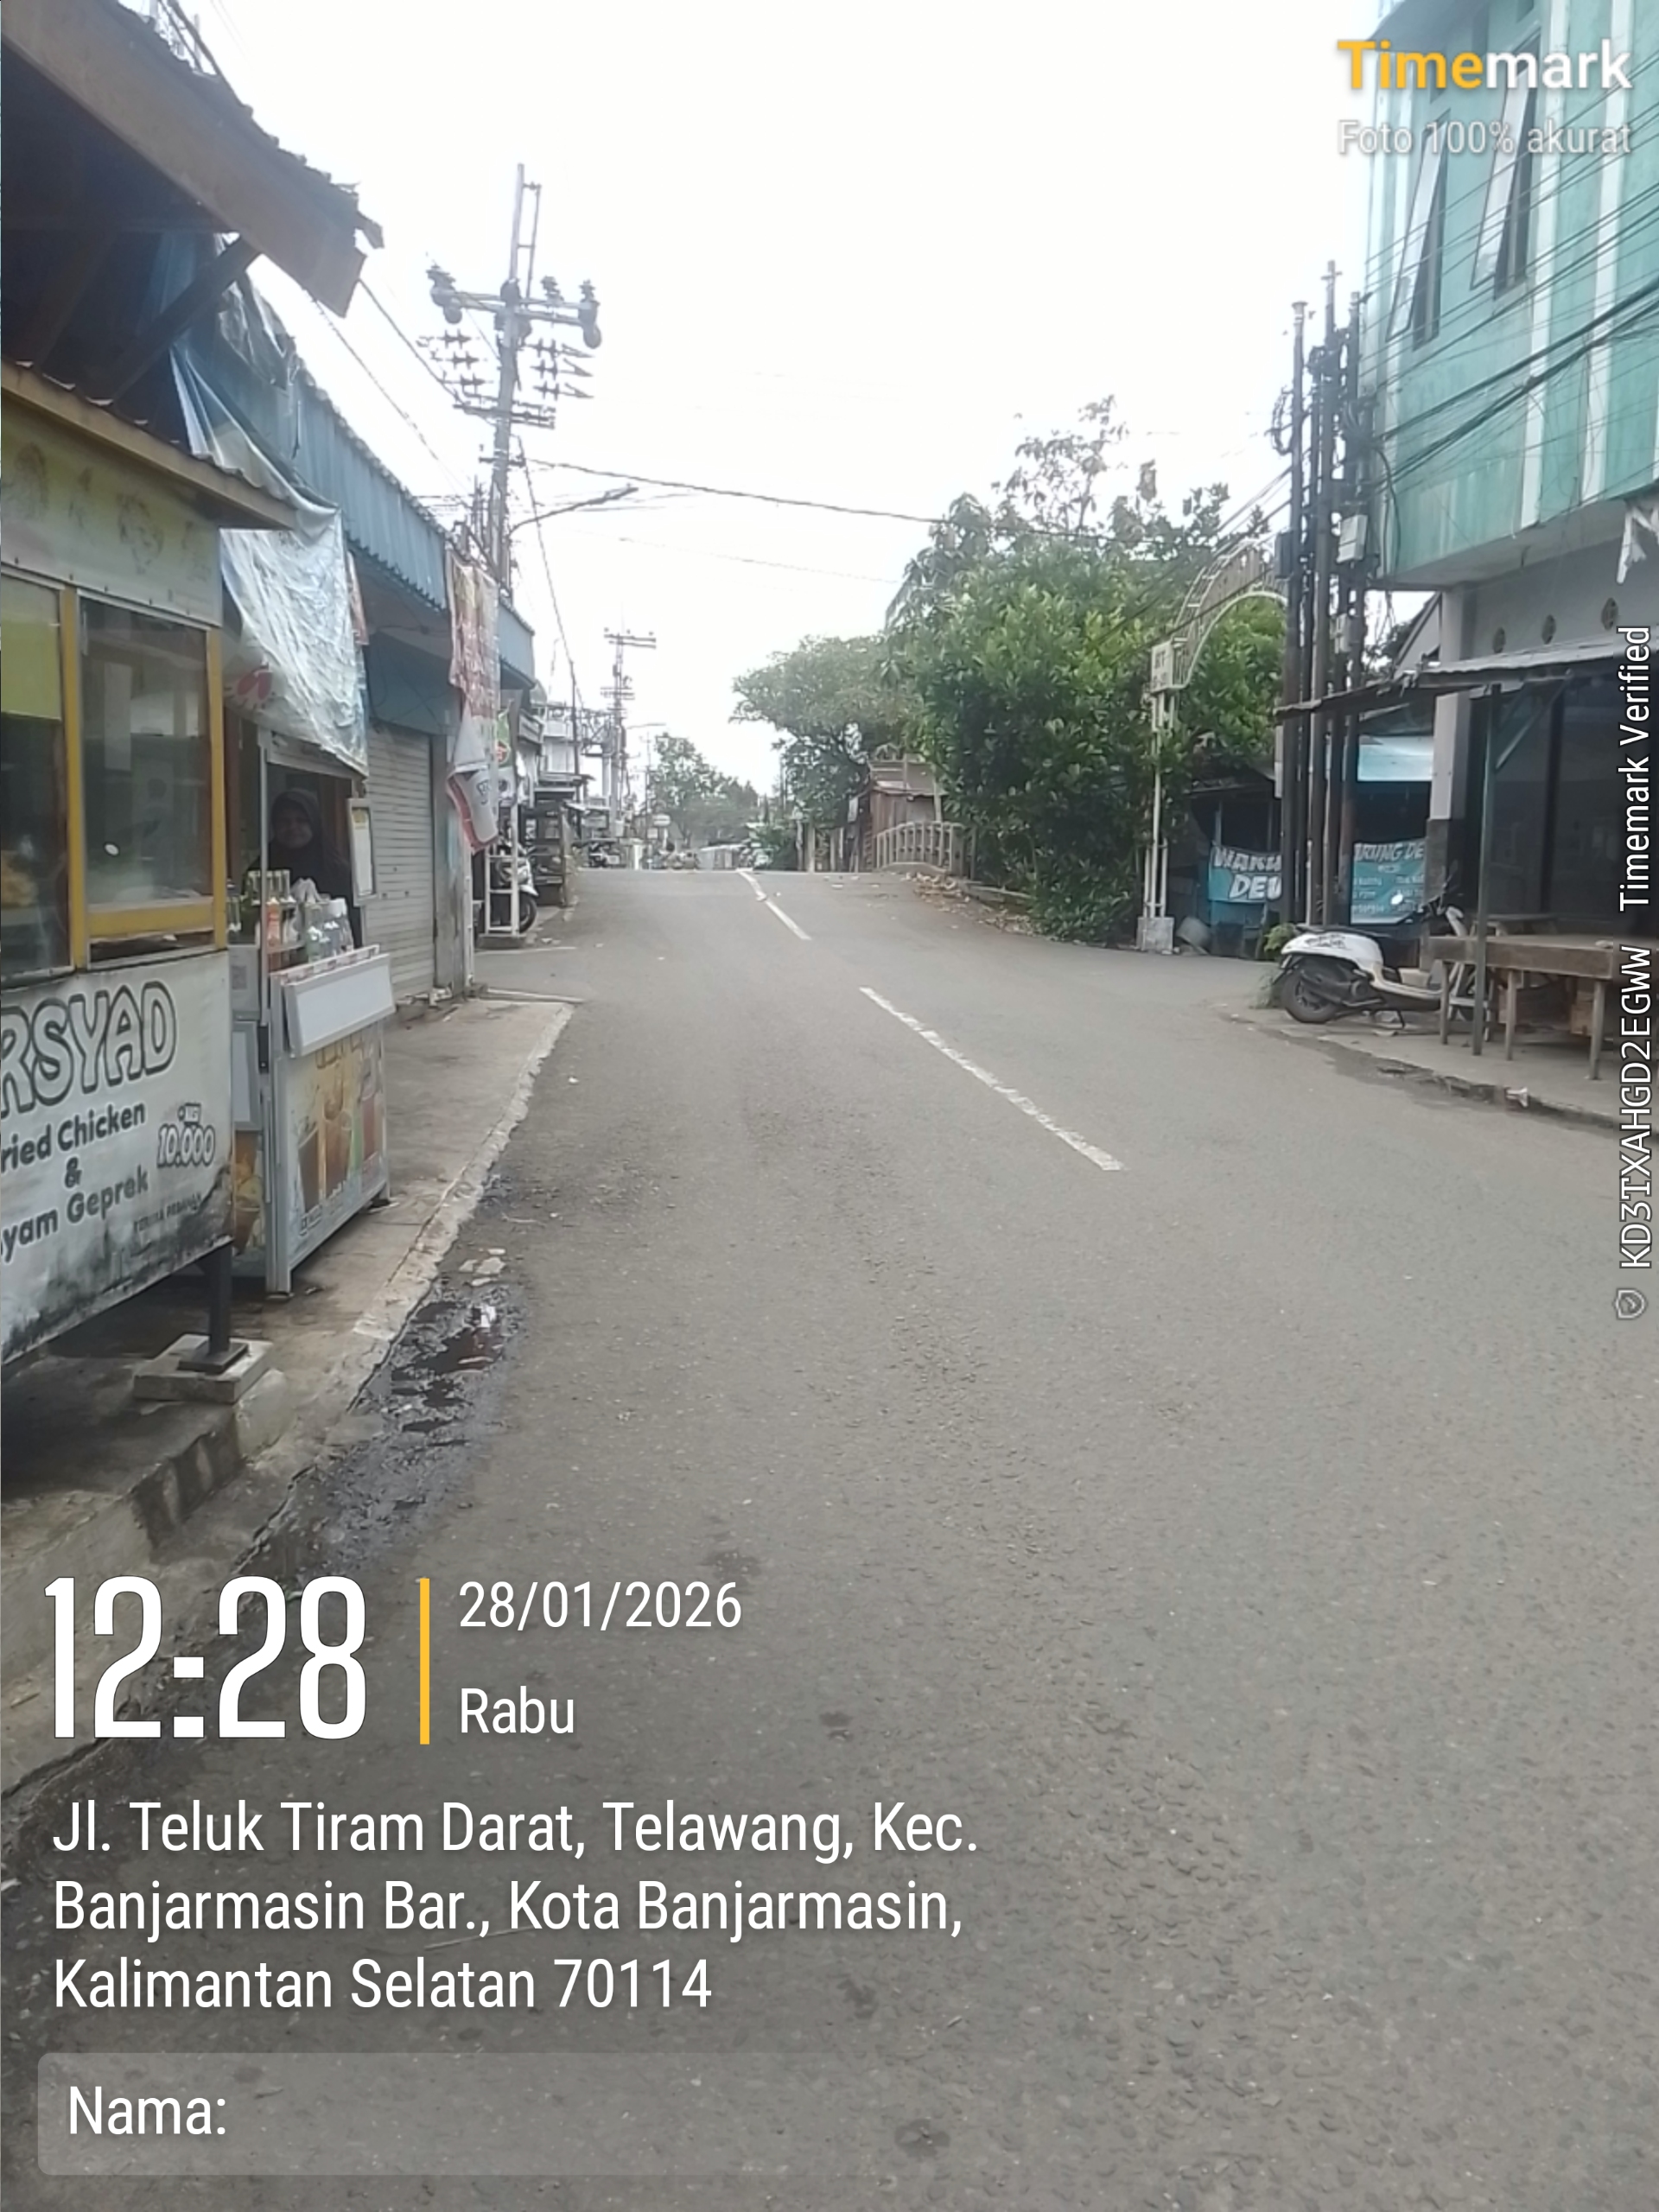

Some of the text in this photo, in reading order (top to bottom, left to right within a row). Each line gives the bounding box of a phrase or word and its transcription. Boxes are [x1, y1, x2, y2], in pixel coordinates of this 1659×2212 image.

[57, 1103, 146, 1152] Chicken
[157, 1122, 216, 1168] 10.000
[64, 1156, 83, 1189] &
[1, 1209, 59, 1263] yam
[67, 1164, 149, 1224] Geprek
